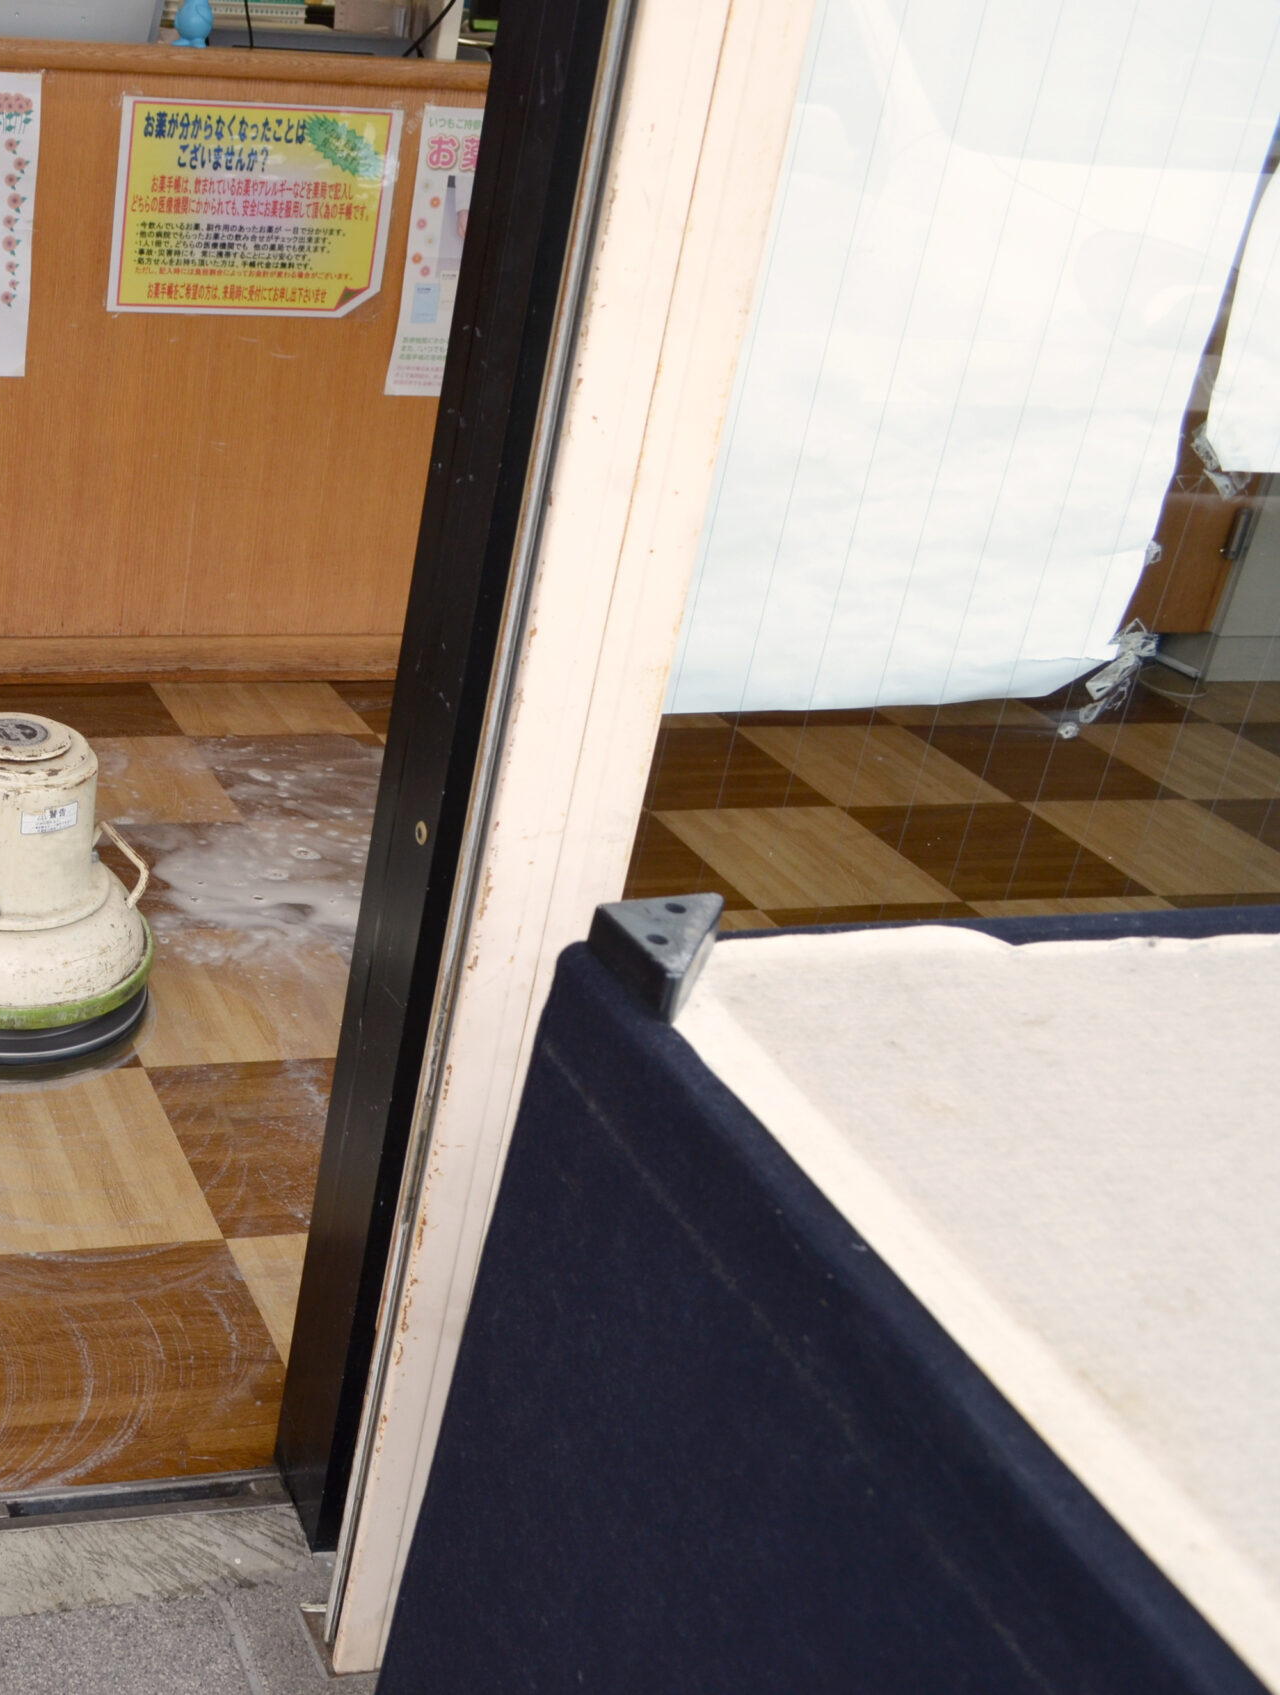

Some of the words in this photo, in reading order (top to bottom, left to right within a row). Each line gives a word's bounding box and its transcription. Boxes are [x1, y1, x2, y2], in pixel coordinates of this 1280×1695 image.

[143, 111, 306, 144] お薬が分からなくなったことは
